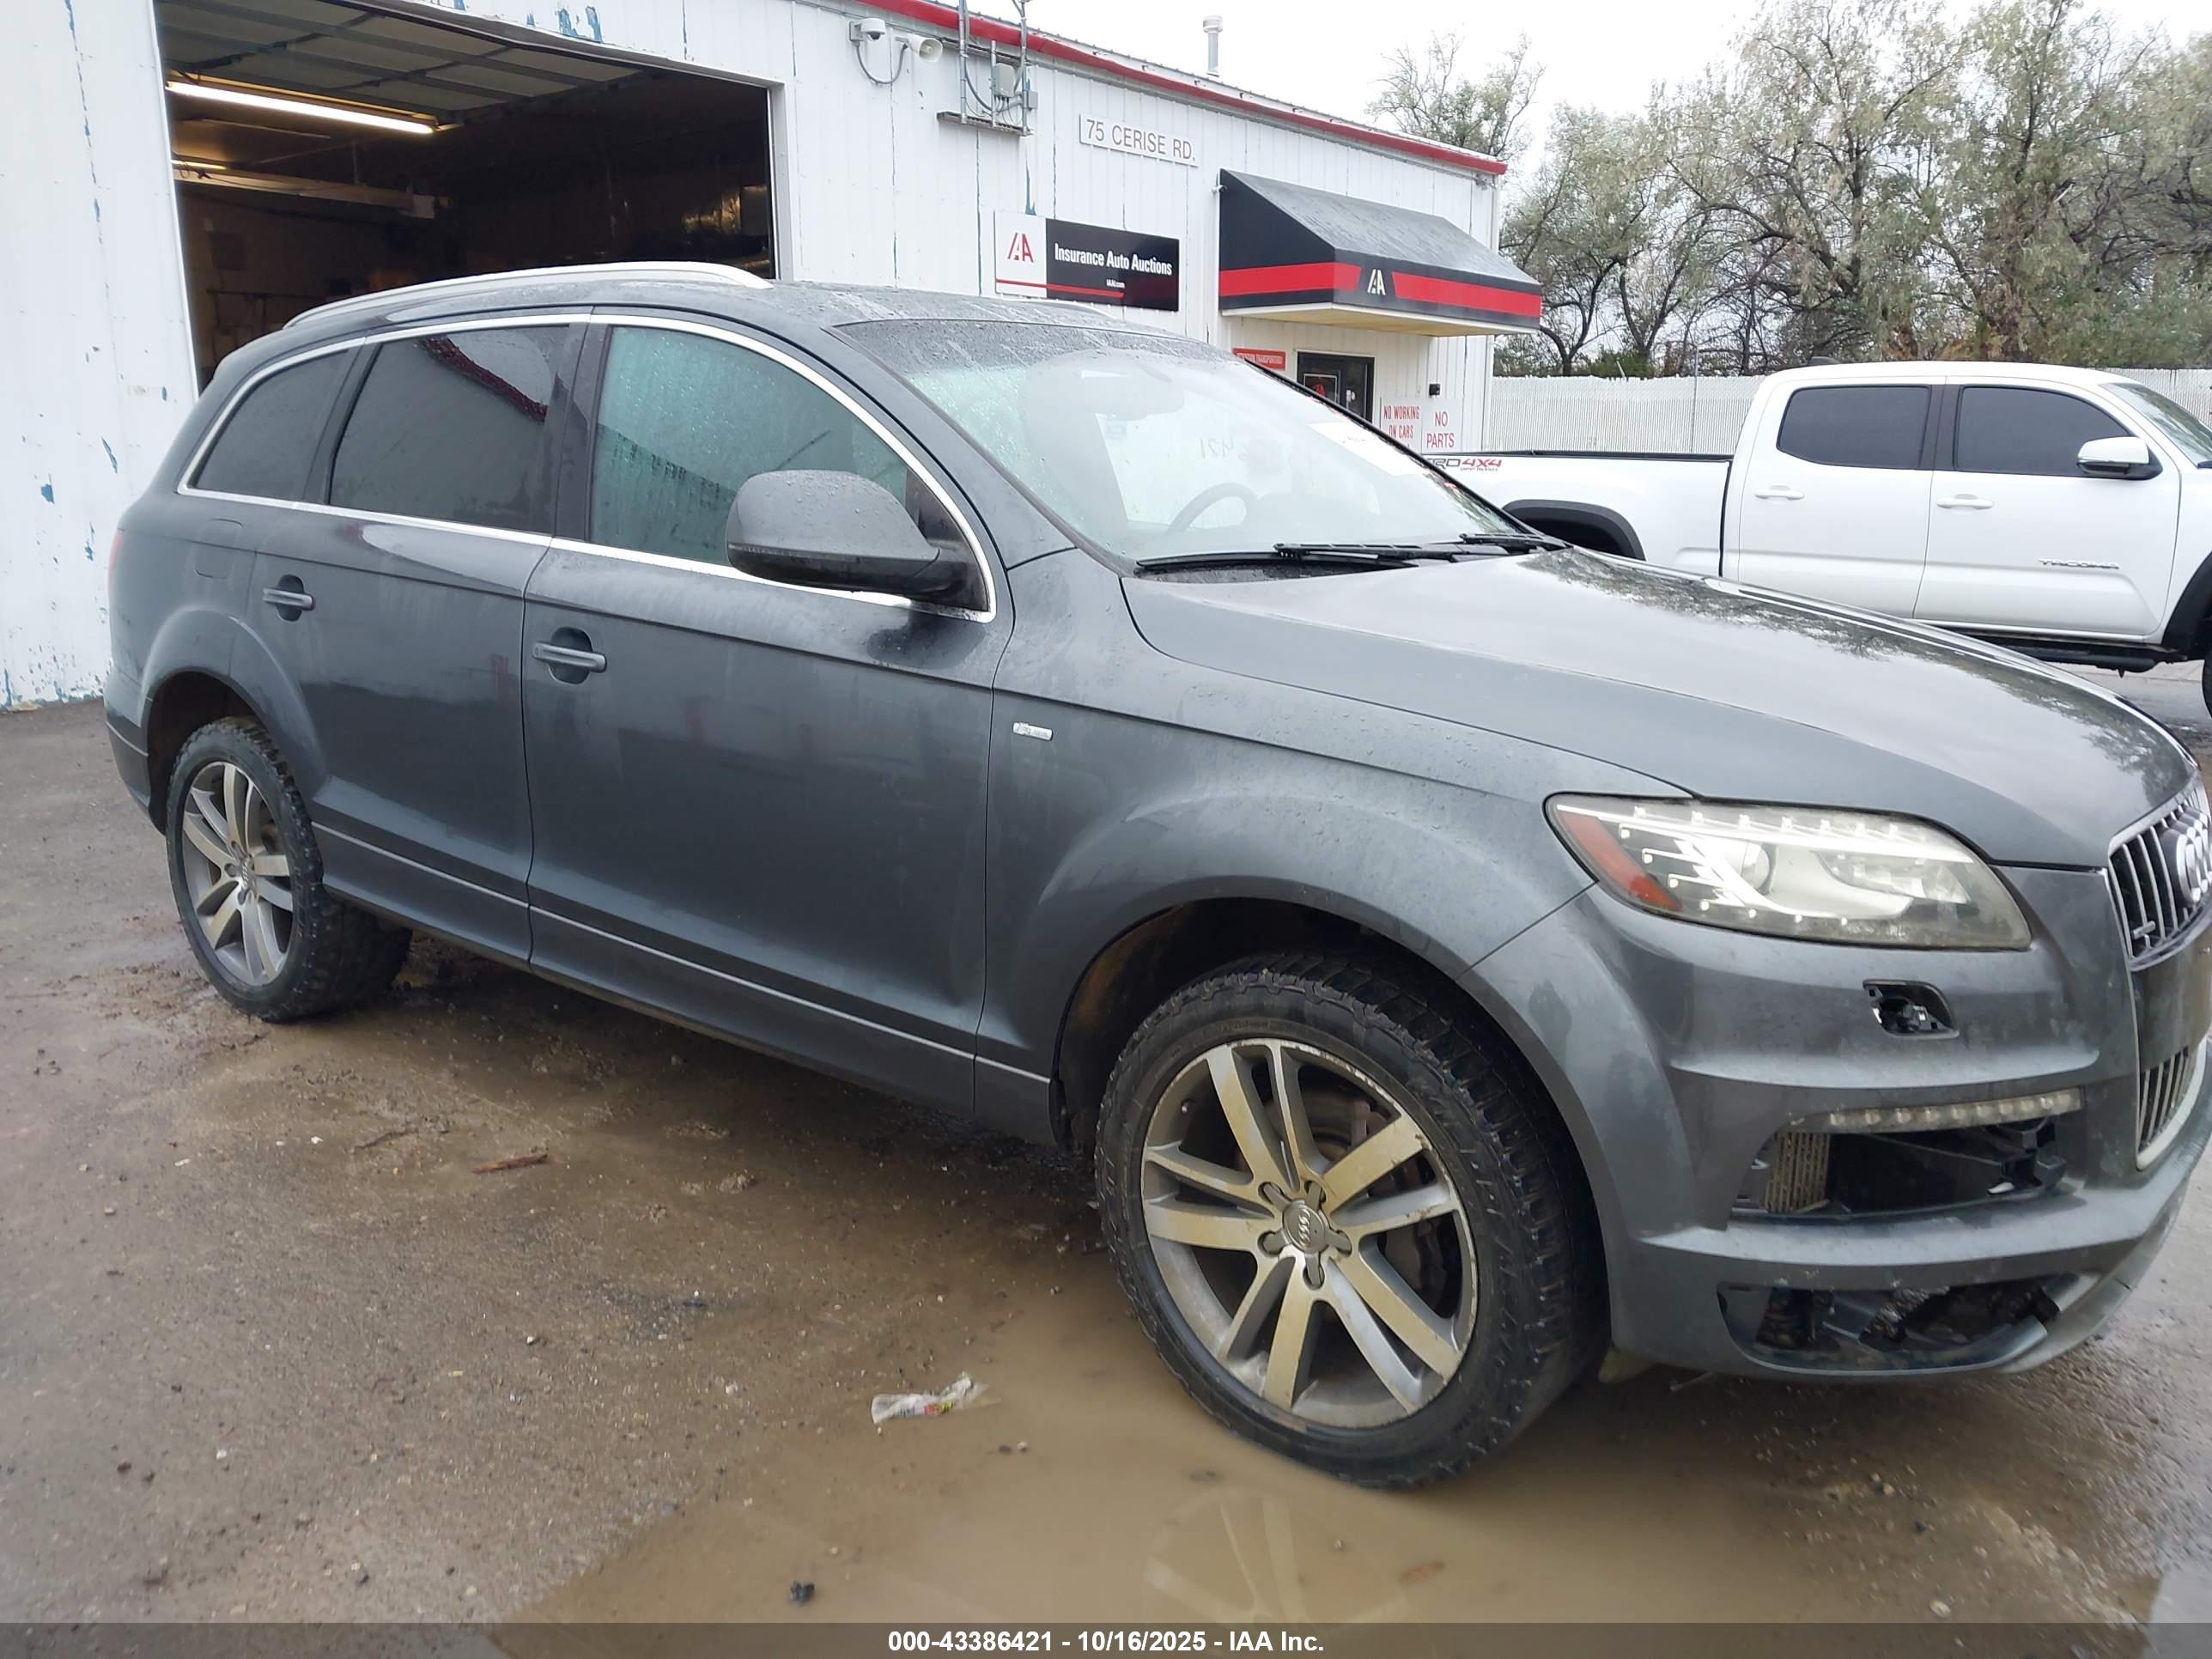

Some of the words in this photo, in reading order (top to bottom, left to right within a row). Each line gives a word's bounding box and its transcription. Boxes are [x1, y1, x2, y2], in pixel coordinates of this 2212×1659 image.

[1086, 118, 1105, 142] 75
[1111, 125, 1166, 155] CERISE
[1173, 138, 1196, 161] RD.
[1054, 242, 1104, 266] Insurance
[1106, 250, 1130, 270] Auto
[1131, 254, 1173, 276] Auctions
[1383, 405, 1392, 420] NO
[1394, 405, 1420, 420] WORKING
[1435, 411, 1449, 427] NO
[1389, 424, 1397, 438] ON
[1399, 425, 1414, 440] CARS
[1426, 432, 1455, 448] PARTS
